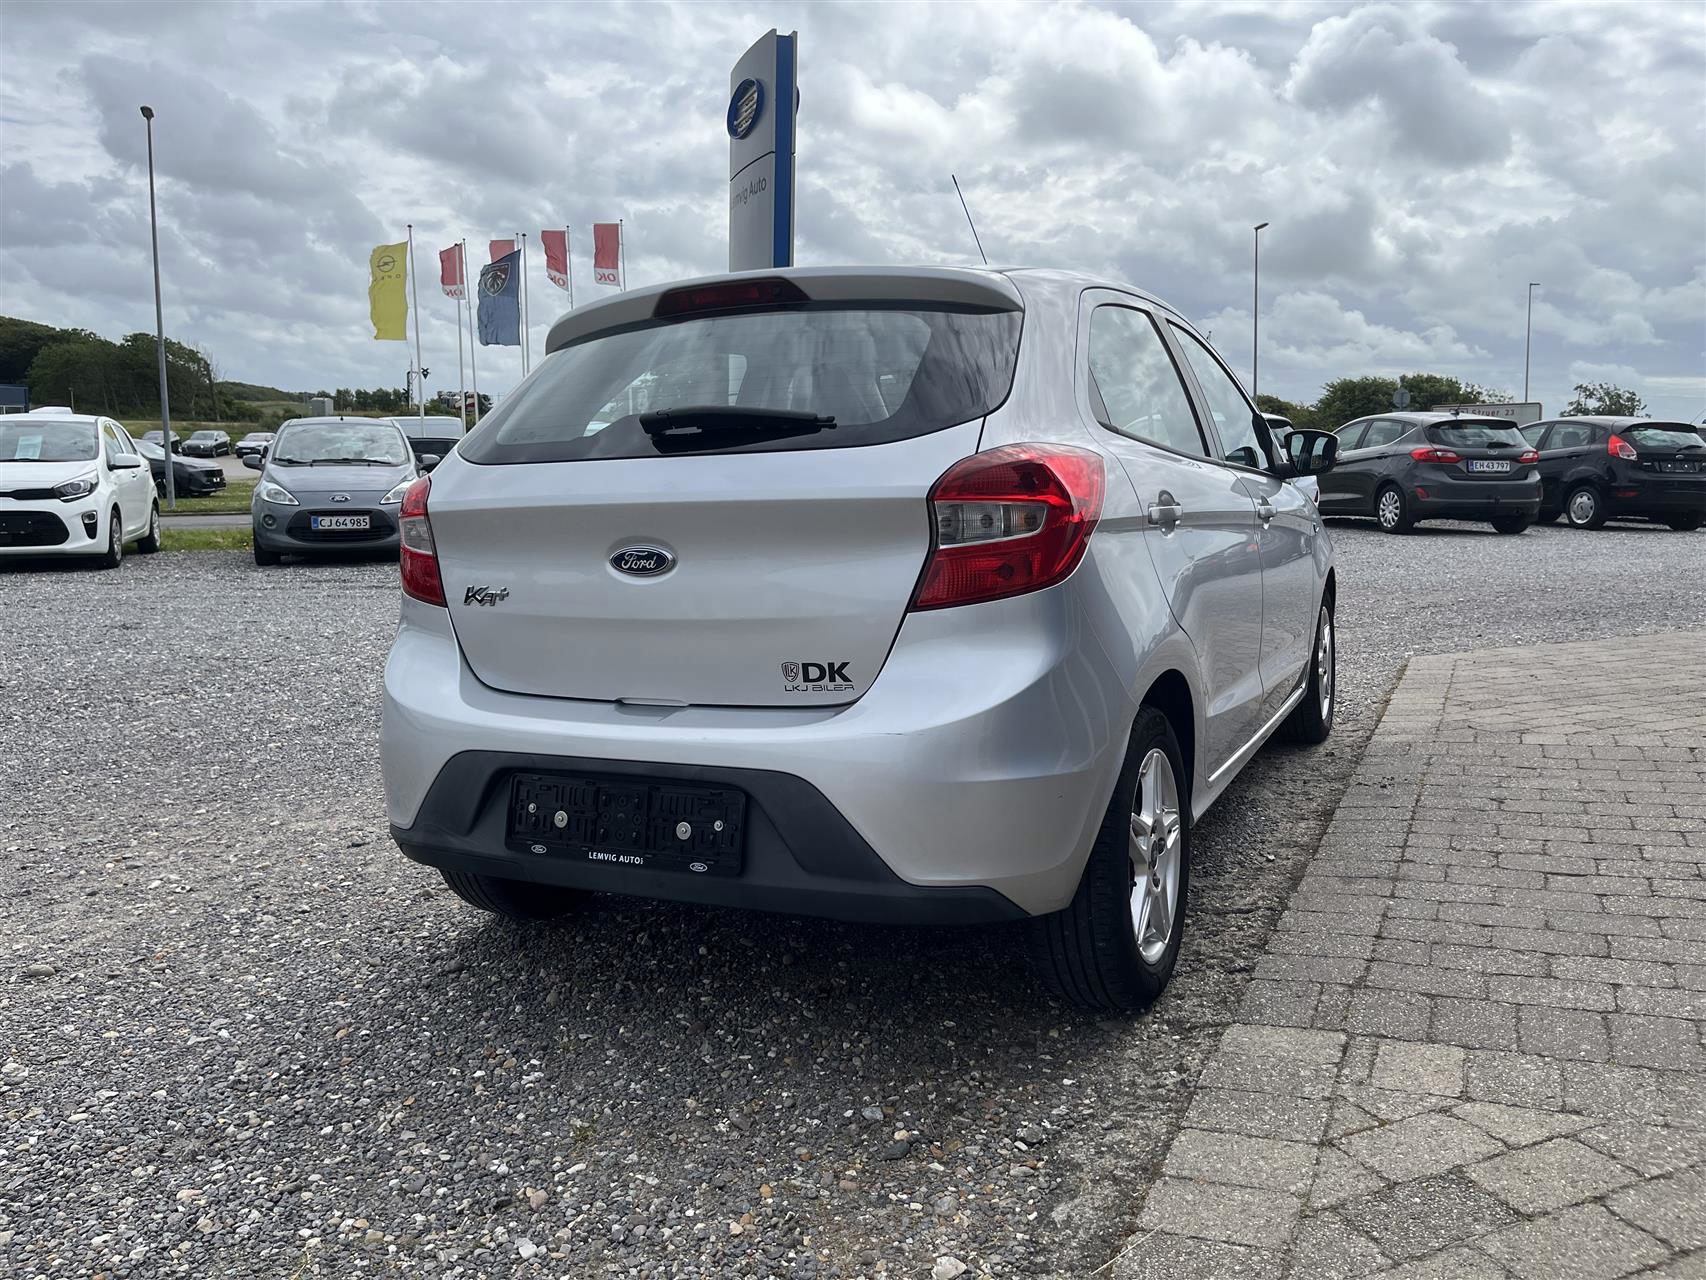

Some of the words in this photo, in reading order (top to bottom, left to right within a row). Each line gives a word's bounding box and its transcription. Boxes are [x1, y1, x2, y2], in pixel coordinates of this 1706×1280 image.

[749, 177, 767, 197] Auto
[1471, 409, 1500, 417] Struer
[1474, 461, 1484, 470] EH
[1486, 462, 1495, 470] 43
[1496, 462, 1509, 470] 797
[319, 518, 333, 527] CJ
[335, 518, 348, 527] 64
[350, 517, 369, 527] 985
[620, 552, 657, 570] Ford
[801, 661, 853, 683] DK
[784, 684, 809, 692] LKJ
[811, 684, 855, 692] BILER
[588, 851, 617, 862] LEMVIG
